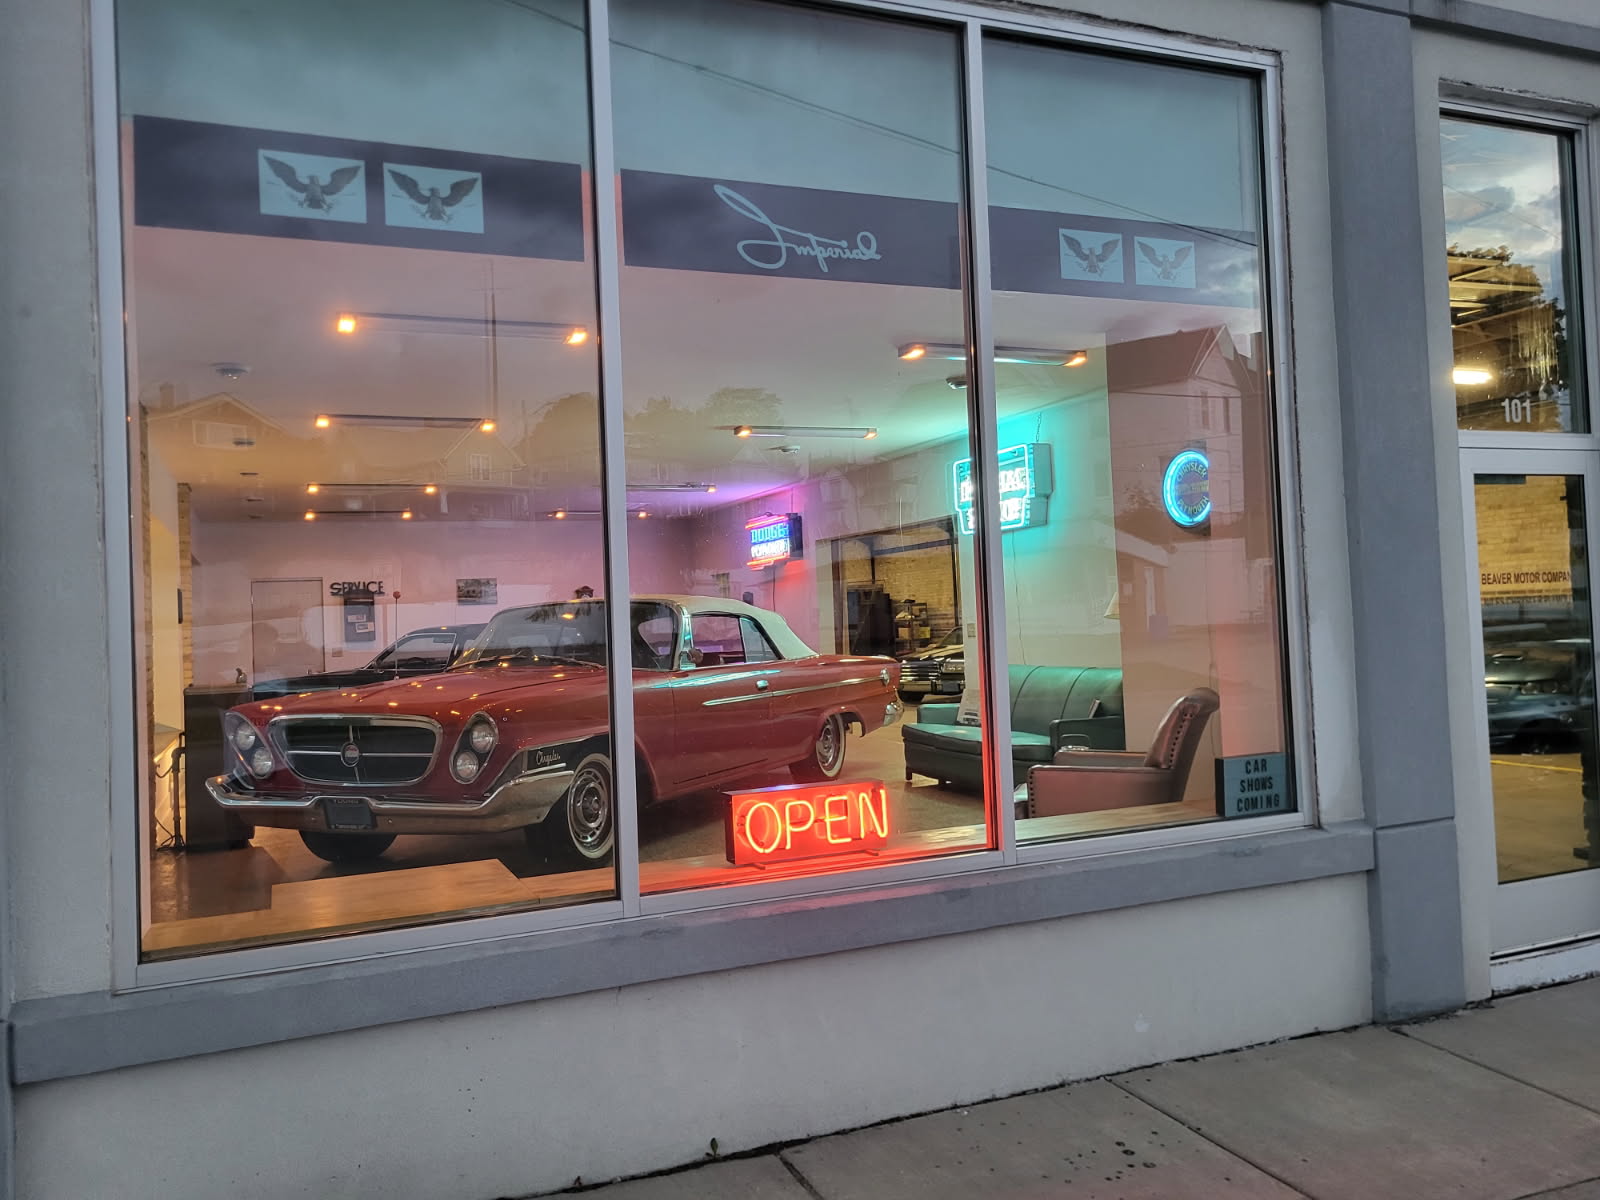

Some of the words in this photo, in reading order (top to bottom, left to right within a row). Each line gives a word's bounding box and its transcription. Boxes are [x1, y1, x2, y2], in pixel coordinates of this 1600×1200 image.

[713, 183, 882, 273] Imperial
[1501, 398, 1531, 424] 101
[1176, 462, 1207, 482] CHRYSLER
[1481, 572, 1512, 585] BEAVER
[1513, 571, 1541, 584] MOTOR
[1245, 758, 1267, 775] CAR
[1240, 776, 1273, 793] SHOWS
[1236, 793, 1280, 812] COMING
[745, 788, 889, 854] OPEN
